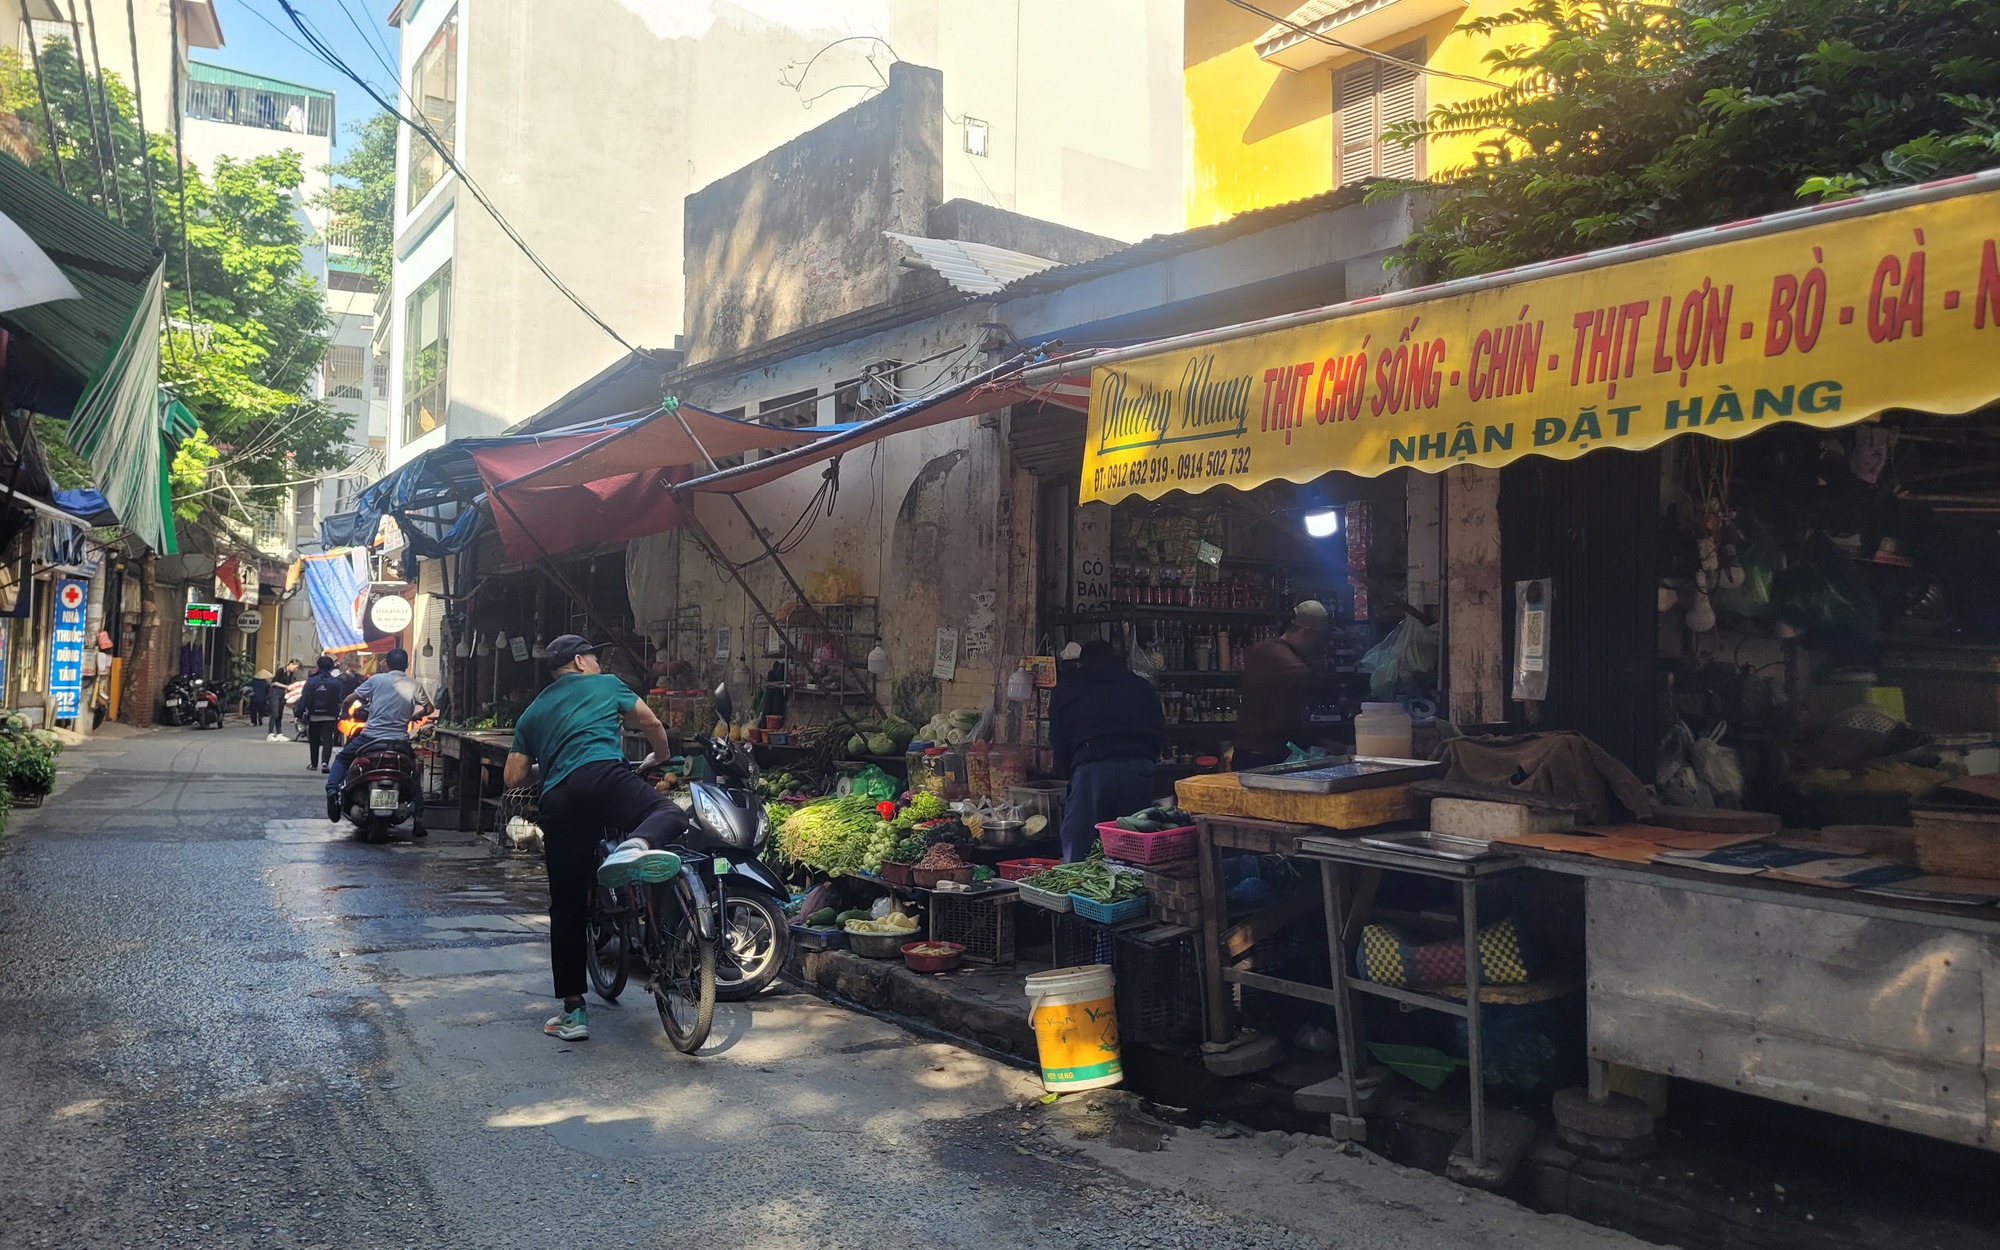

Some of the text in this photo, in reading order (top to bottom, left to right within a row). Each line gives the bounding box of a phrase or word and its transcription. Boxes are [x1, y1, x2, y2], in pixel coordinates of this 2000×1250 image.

[1261, 361, 1315, 446] THỊT
[1315, 334, 1371, 426] CHÓ
[1370, 316, 1446, 418] SỐNG
[1467, 304, 1544, 403] CHÍN
[1570, 300, 1649, 400] THỊT
[1652, 276, 1733, 388] LỢN
[1764, 246, 1827, 358] BÒ
[1867, 228, 1926, 344] GÀ
[1178, 354, 1254, 439] Nhung
[1388, 380, 1843, 465] NHẬN ĐẶT HÀNG
[1094, 468, 1106, 493] ĐT:
[1107, 461, 1128, 489] 0912
[1129, 458, 1148, 486] 632
[1149, 455, 1169, 484] 919
[1177, 452, 1203, 480] 0914
[1205, 449, 1226, 476] 502
[1229, 445, 1251, 475] 732
[1083, 557, 1103, 576] CÓ
[1077, 578, 1108, 597] BÁN
[62, 609, 80, 623] NHÀ
[56, 625, 82, 643] THUỐC
